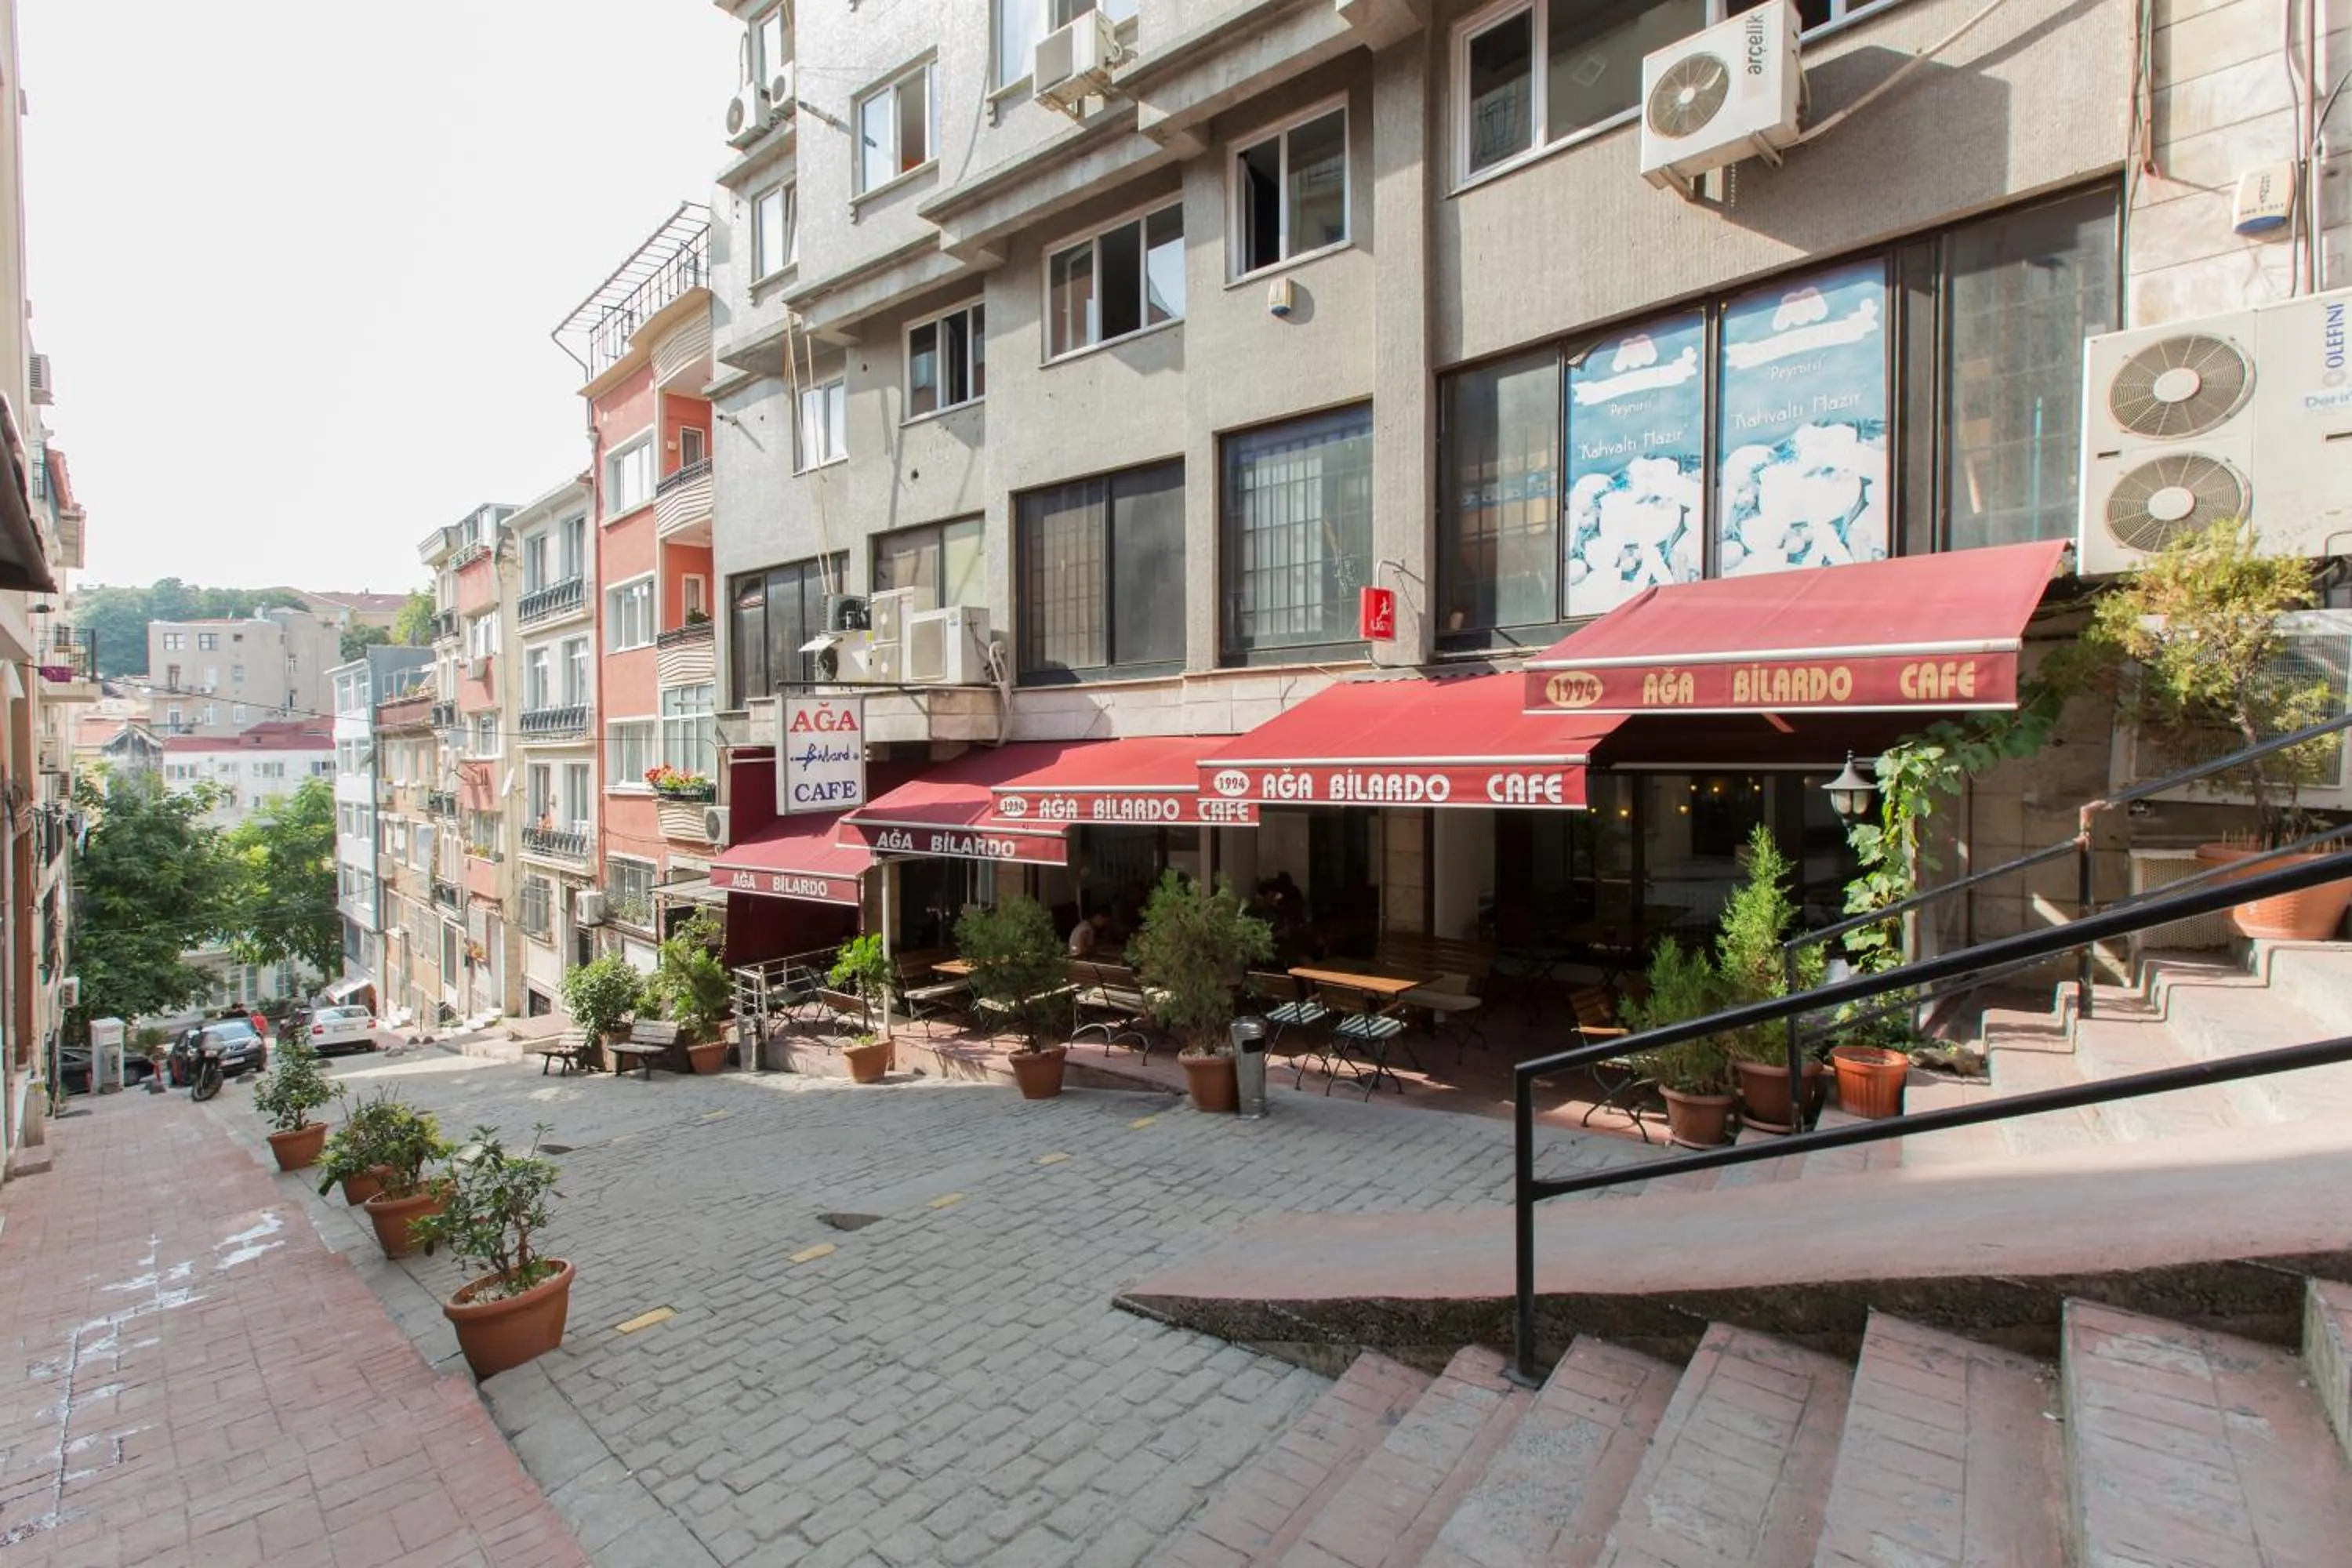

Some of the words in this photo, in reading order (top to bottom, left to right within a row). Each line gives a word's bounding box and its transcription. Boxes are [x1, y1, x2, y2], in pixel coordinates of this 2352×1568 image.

[1746, 14, 1766, 75] arçelik
[2325, 303, 2345, 368] OLEFINI
[1552, 676, 1598, 702] 1994
[1643, 667, 1694, 704] AĞA
[1733, 663, 1853, 702] BİLARDO
[1900, 661, 1976, 699] CAFE
[789, 702, 858, 733] AĞA
[795, 781, 857, 803] CAFE
[1262, 768, 1312, 799] AĞA
[1329, 768, 1450, 801] BİLARDO
[1486, 772, 1563, 804] CAFE
[1039, 793, 1078, 819] AĞA
[1093, 794, 1180, 821] BİLARDO
[1197, 801, 1250, 822] CAFE
[877, 828, 913, 851] AĞA
[931, 831, 1016, 858] BİLARDO
[731, 870, 757, 890] AĞA
[772, 874, 828, 898] BİLARDO
